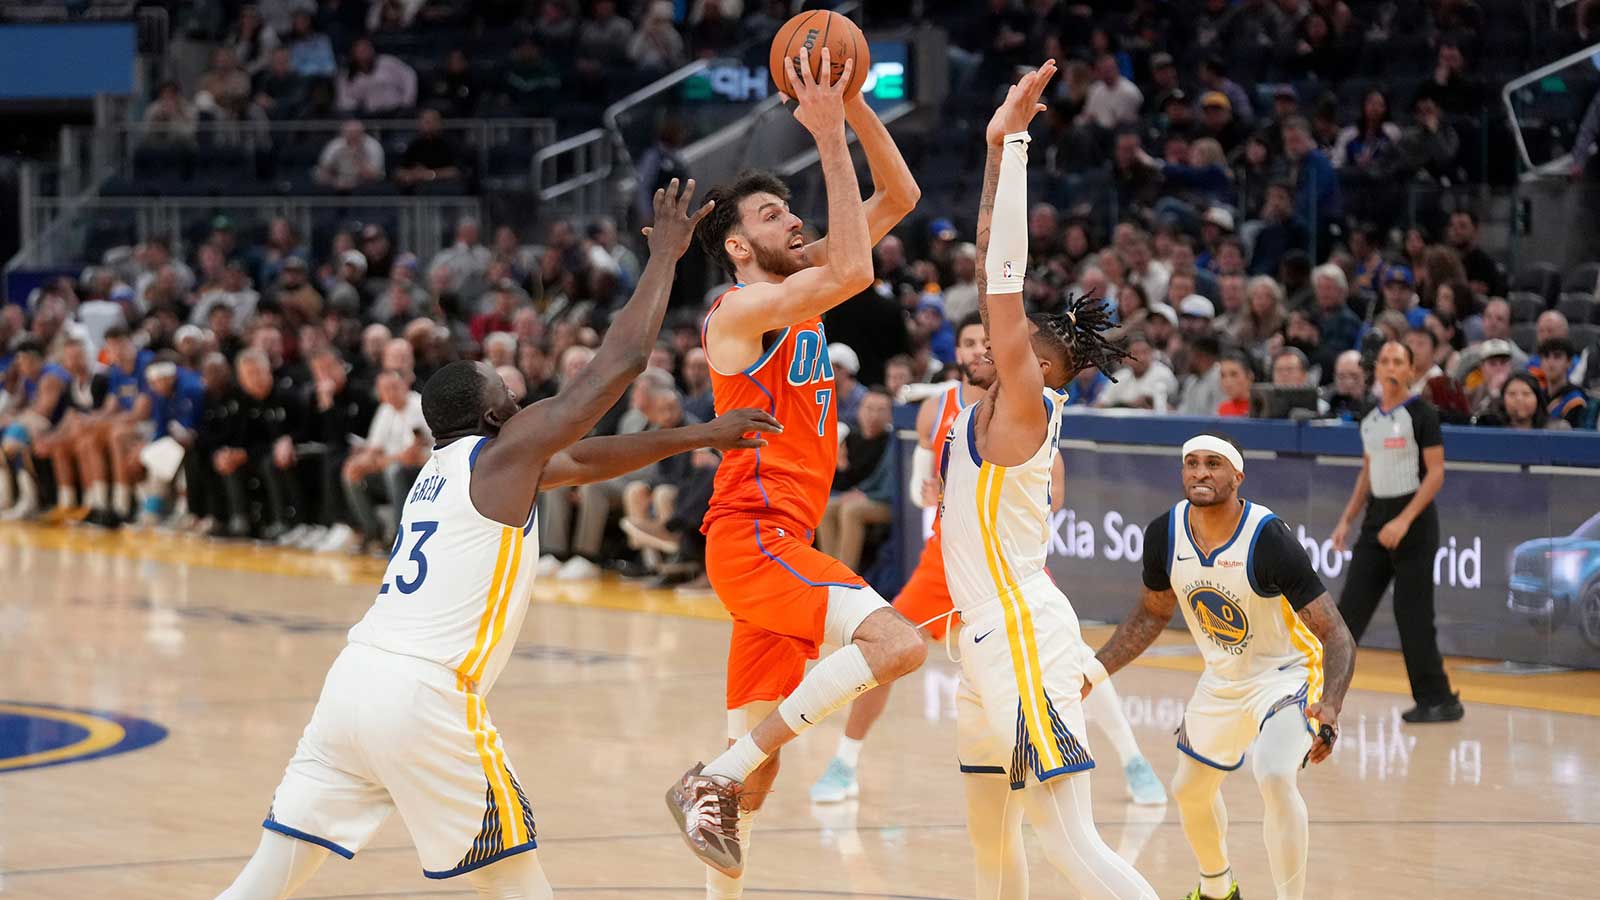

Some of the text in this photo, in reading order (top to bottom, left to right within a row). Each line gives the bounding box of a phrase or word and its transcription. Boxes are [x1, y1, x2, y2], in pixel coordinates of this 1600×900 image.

[816, 389, 832, 436] 7
[410, 474, 447, 504] GREEN
[1048, 508, 1094, 559] Kia
[1217, 560, 1244, 568] Rakuten
[1182, 580, 1241, 604] GOLDEN STATE
[1222, 605, 1233, 622] 0
